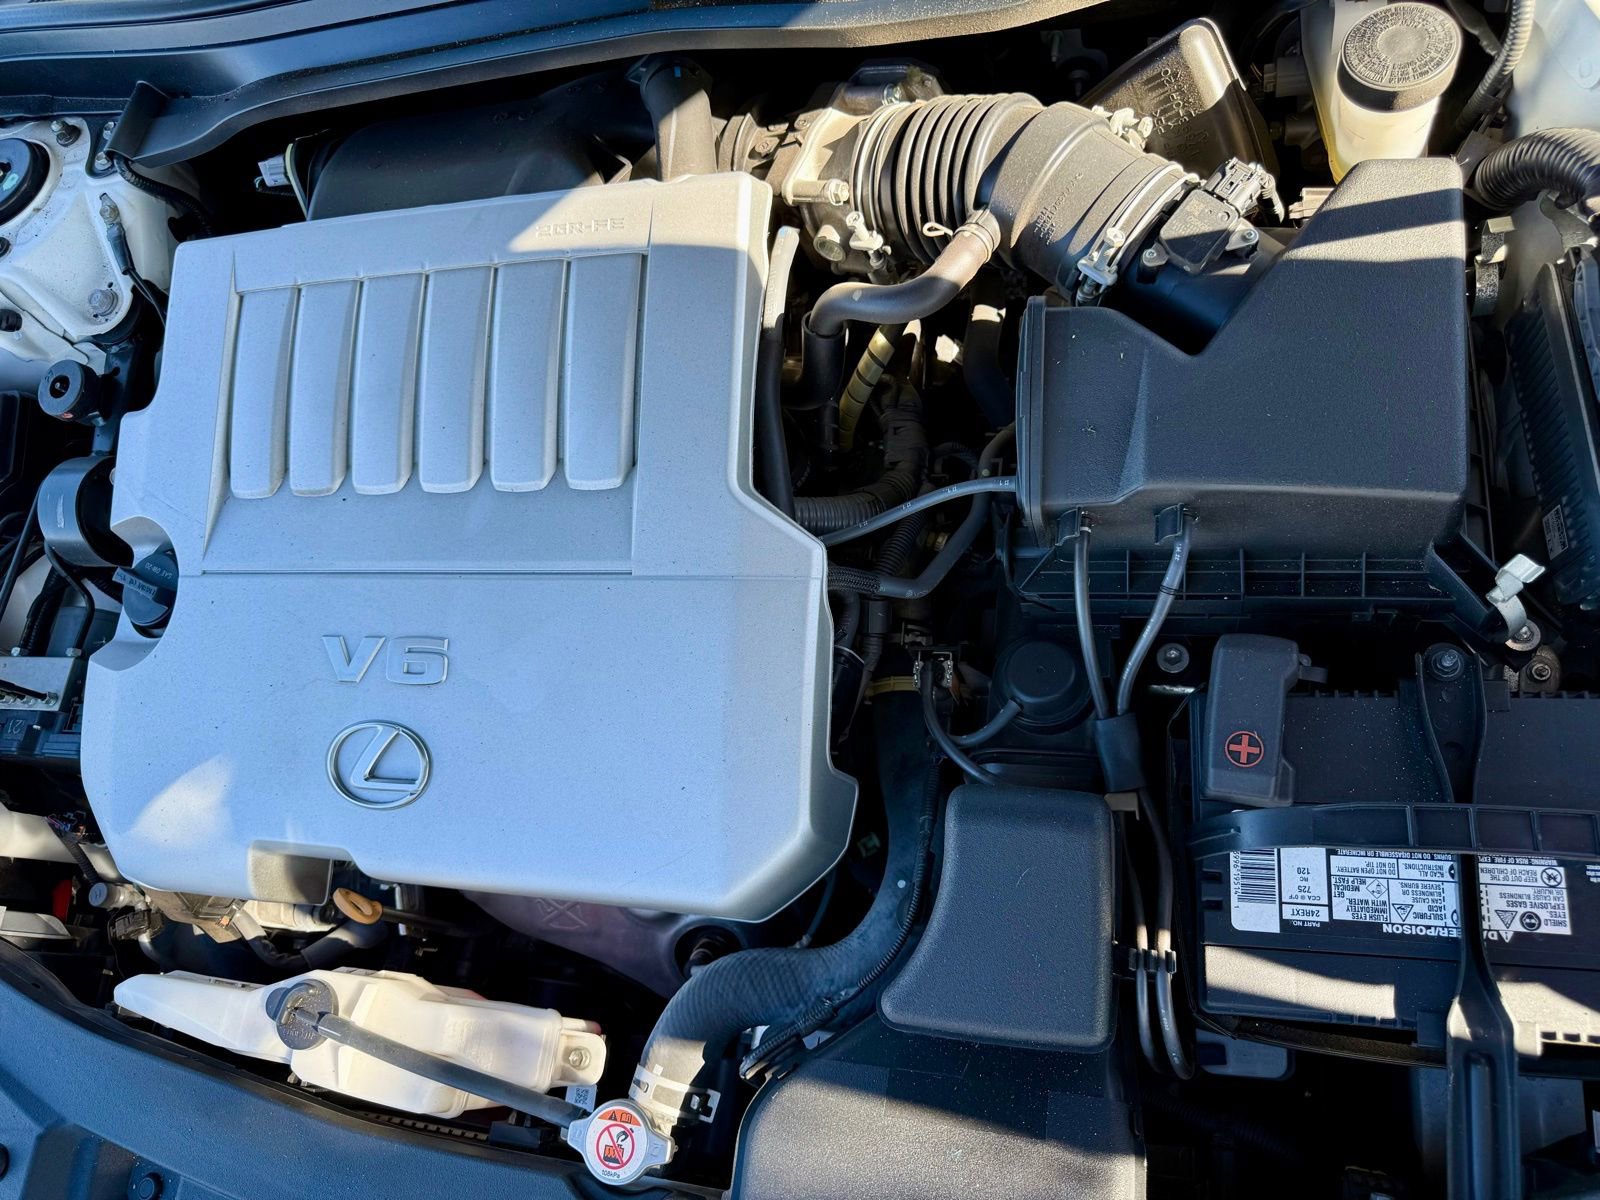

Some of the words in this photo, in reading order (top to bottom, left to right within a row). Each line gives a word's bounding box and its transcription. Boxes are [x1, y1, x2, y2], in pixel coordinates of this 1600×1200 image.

[536, 217, 625, 238] 2GR-FE
[321, 633, 450, 686] V6
[1297, 885, 1311, 893] 725
[1333, 884, 1360, 892] MEDICAL
[1291, 908, 1320, 917] 24REXT
[1345, 905, 1387, 914] IMMEDIATELY
[1412, 912, 1443, 921] SULFURIC
